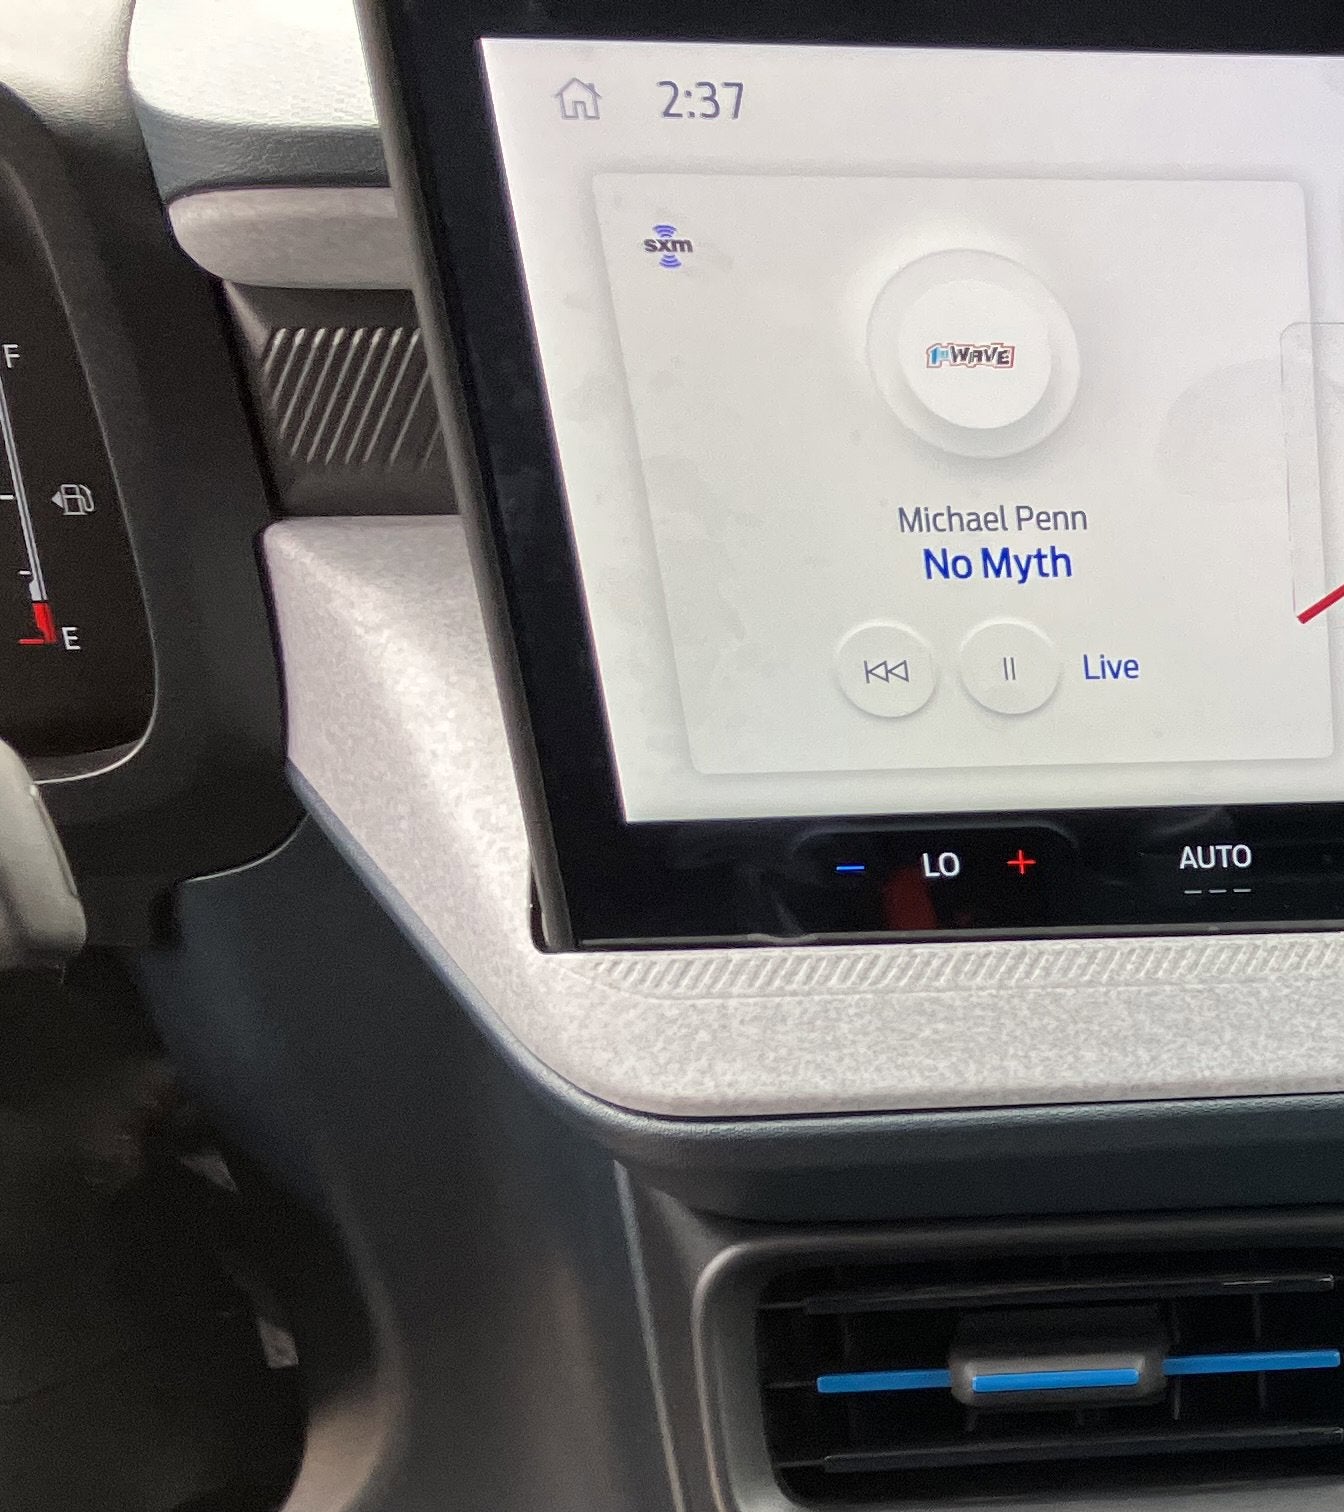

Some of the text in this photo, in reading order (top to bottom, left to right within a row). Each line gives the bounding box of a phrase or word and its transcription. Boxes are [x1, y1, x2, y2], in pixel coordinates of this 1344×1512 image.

[656, 80, 744, 120] 2:37
[643, 238, 695, 253] sxm
[3, 344, 20, 368] F
[897, 505, 1088, 533] Michael Penn
[923, 545, 1073, 585] No Myth
[62, 626, 81, 650] E
[1083, 653, 1140, 681] Live
[922, 851, 960, 879] LO
[1179, 844, 1253, 869] AUTO
